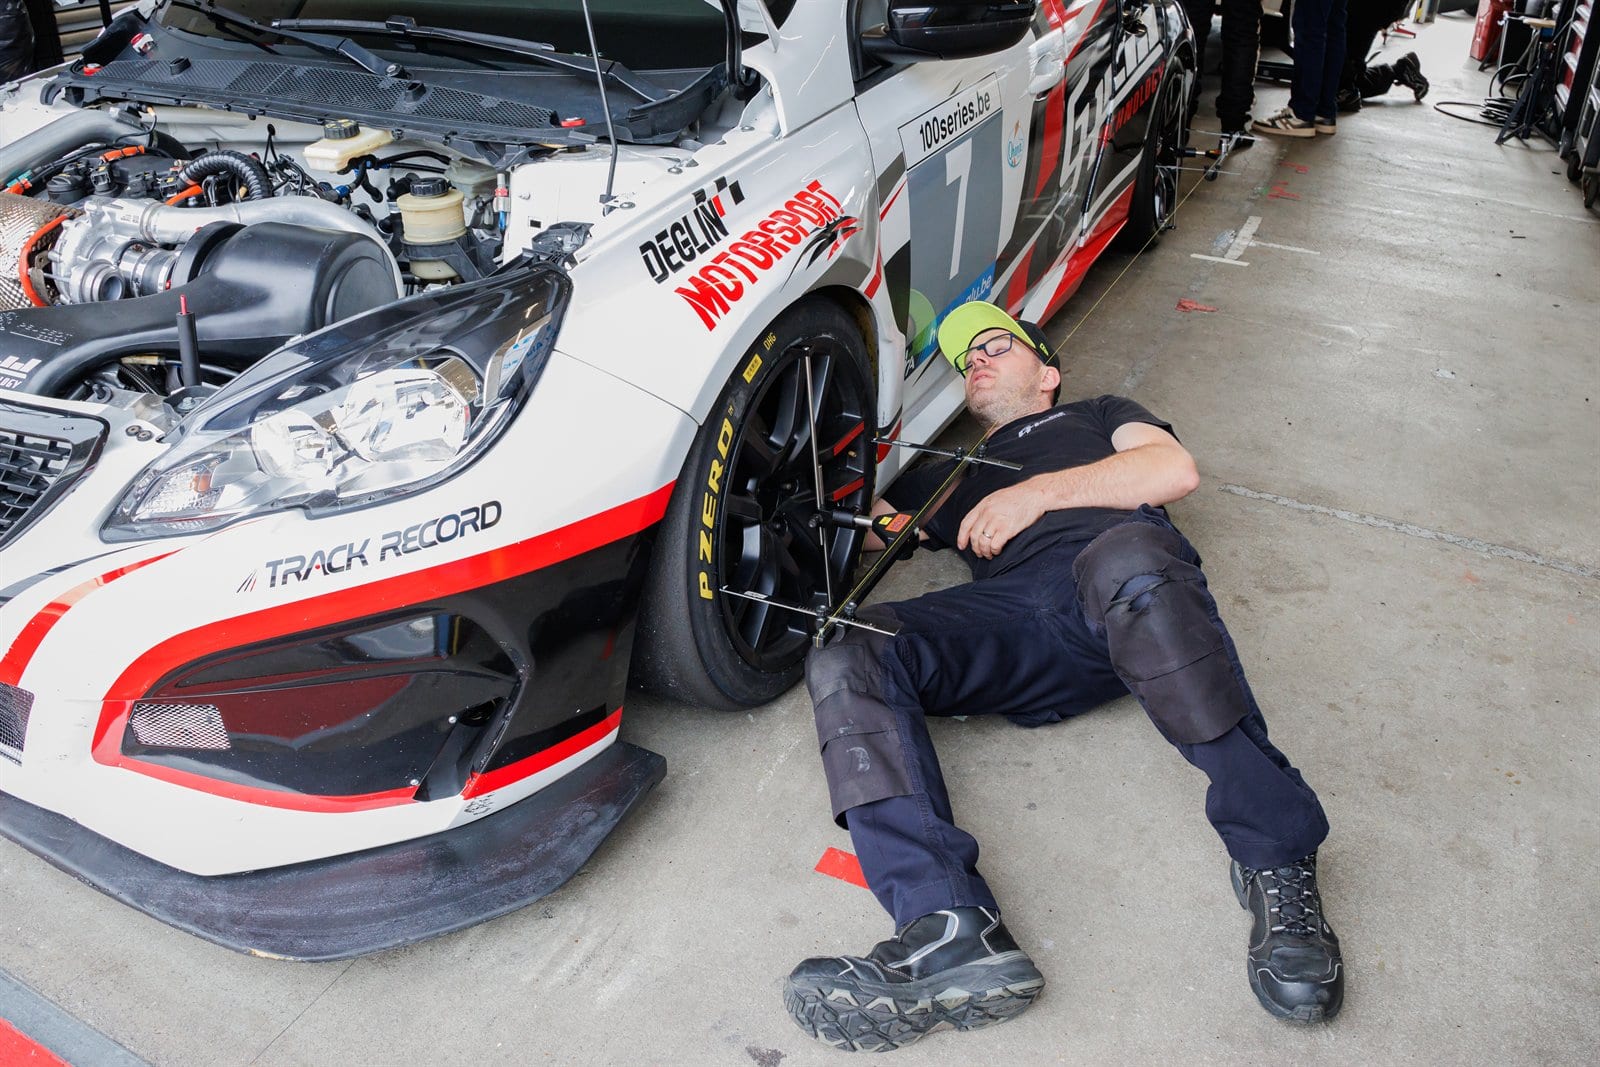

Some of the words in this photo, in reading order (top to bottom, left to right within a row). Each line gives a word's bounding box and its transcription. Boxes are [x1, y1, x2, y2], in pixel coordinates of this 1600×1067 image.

[919, 91, 991, 152] 100series.be
[639, 197, 730, 285] DEGLIN
[945, 137, 973, 280] 7
[674, 179, 845, 332] MOTORSPORT
[699, 417, 734, 565] ZERO
[265, 538, 371, 588] TRACK
[379, 500, 502, 562] RECORD
[699, 571, 714, 600] P
